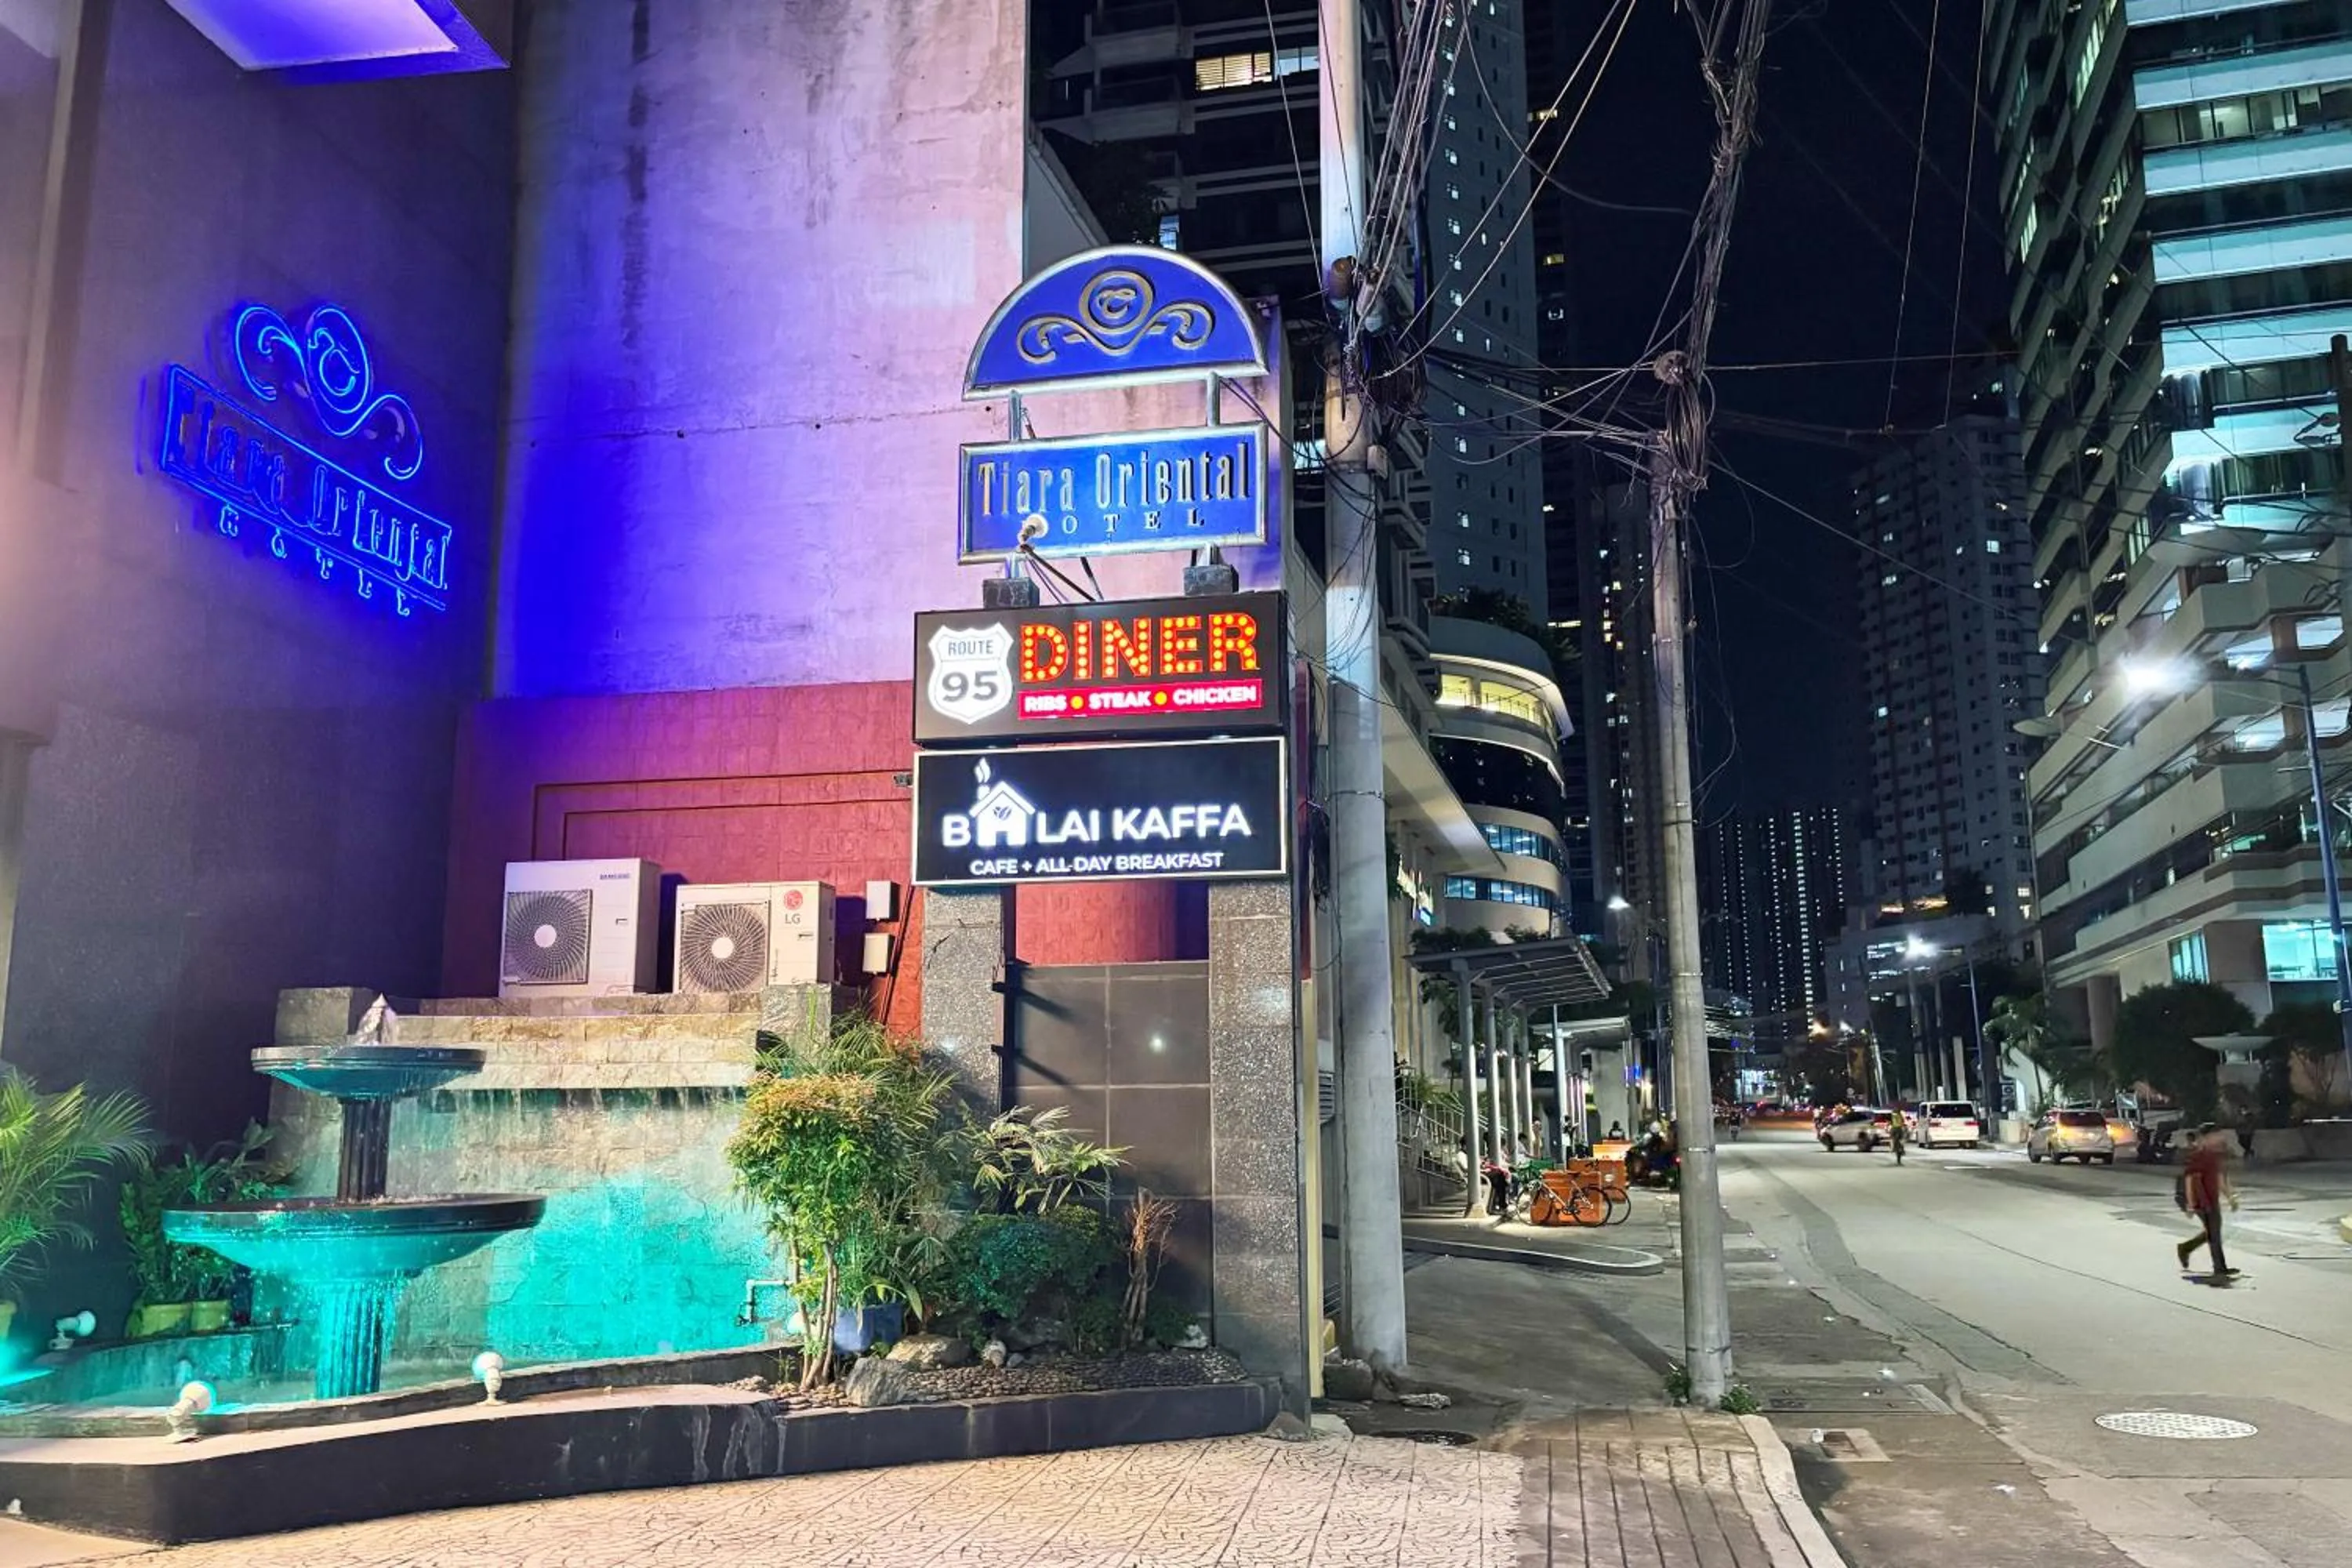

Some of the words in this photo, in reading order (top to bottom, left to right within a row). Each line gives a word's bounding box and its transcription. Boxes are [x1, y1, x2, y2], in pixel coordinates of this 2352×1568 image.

[978, 460, 1076, 515] Tiara
[1095, 441, 1250, 509] Oriental
[1021, 508, 1205, 535] OTEL
[947, 638, 994, 656] ROUTE
[1021, 613, 1259, 684] DINER
[942, 670, 1000, 702] 95
[1024, 695, 1067, 712] RIBS
[1088, 691, 1152, 710] STEAK
[1173, 685, 1257, 706] CHICKEN
[1112, 804, 1252, 840] KAFFA
[970, 858, 1018, 876] CAFE
[1036, 855, 1112, 874] ALL-DAY
[1116, 851, 1225, 870] BREAKFAST
[784, 913, 801, 924] LG
